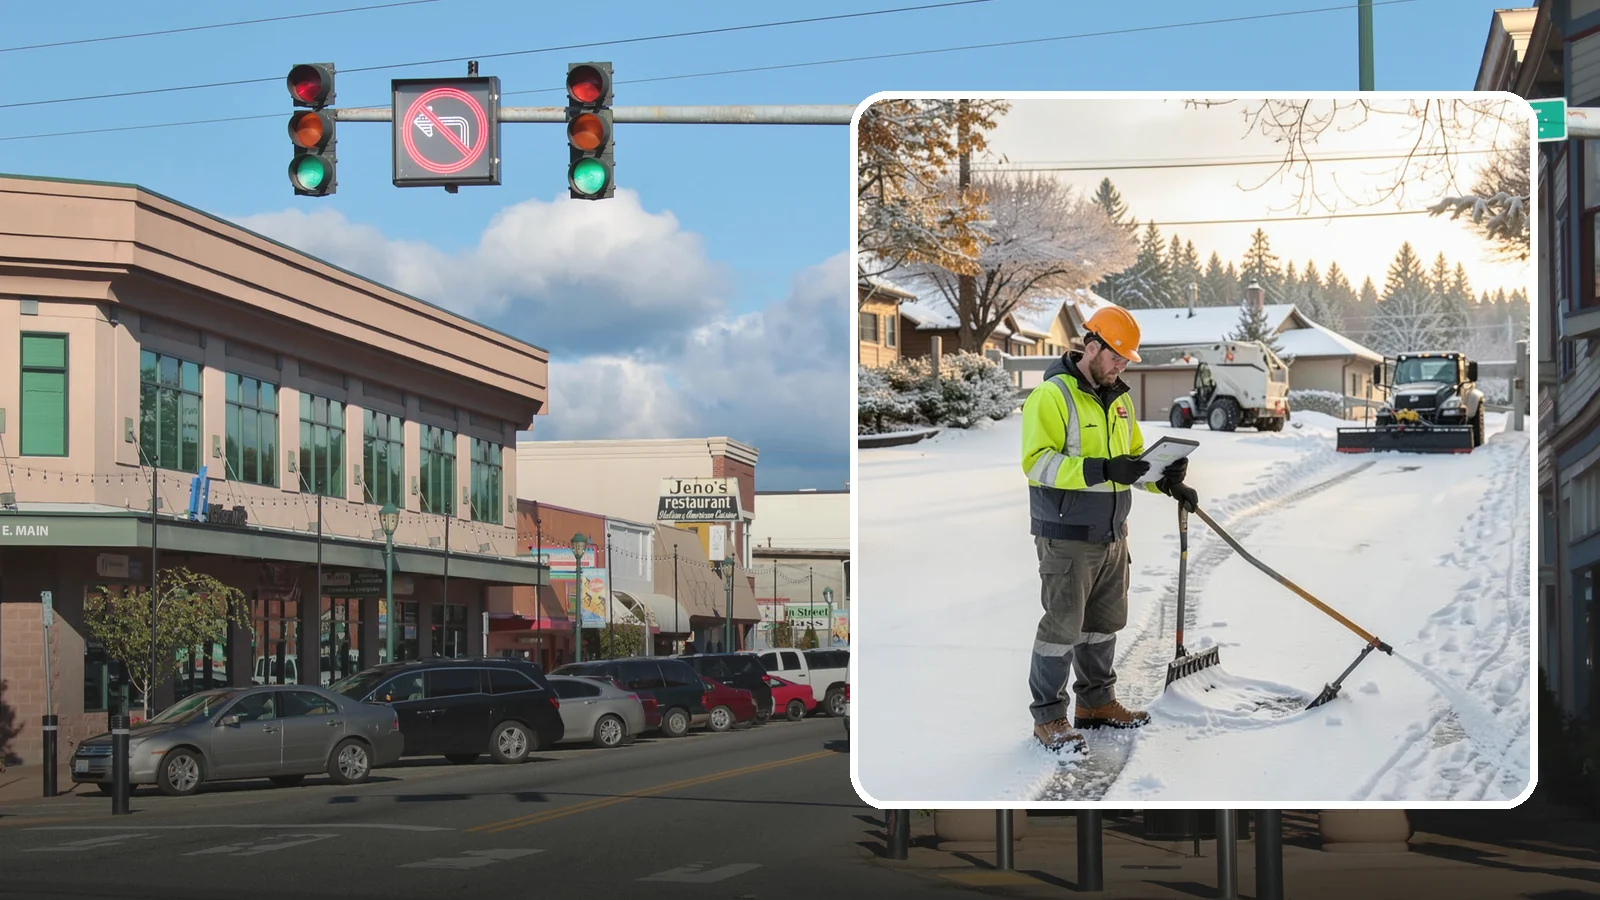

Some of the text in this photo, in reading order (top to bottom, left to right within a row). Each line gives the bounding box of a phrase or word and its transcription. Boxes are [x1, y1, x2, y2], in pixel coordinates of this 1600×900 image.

[670, 480, 727, 494] Jeno's
[665, 497, 731, 509] restaurant
[686, 510, 714, 519] American
[715, 510, 737, 519] Cuisine
[2, 525, 49, 536] E. MAIN
[797, 608, 828, 616] Street
